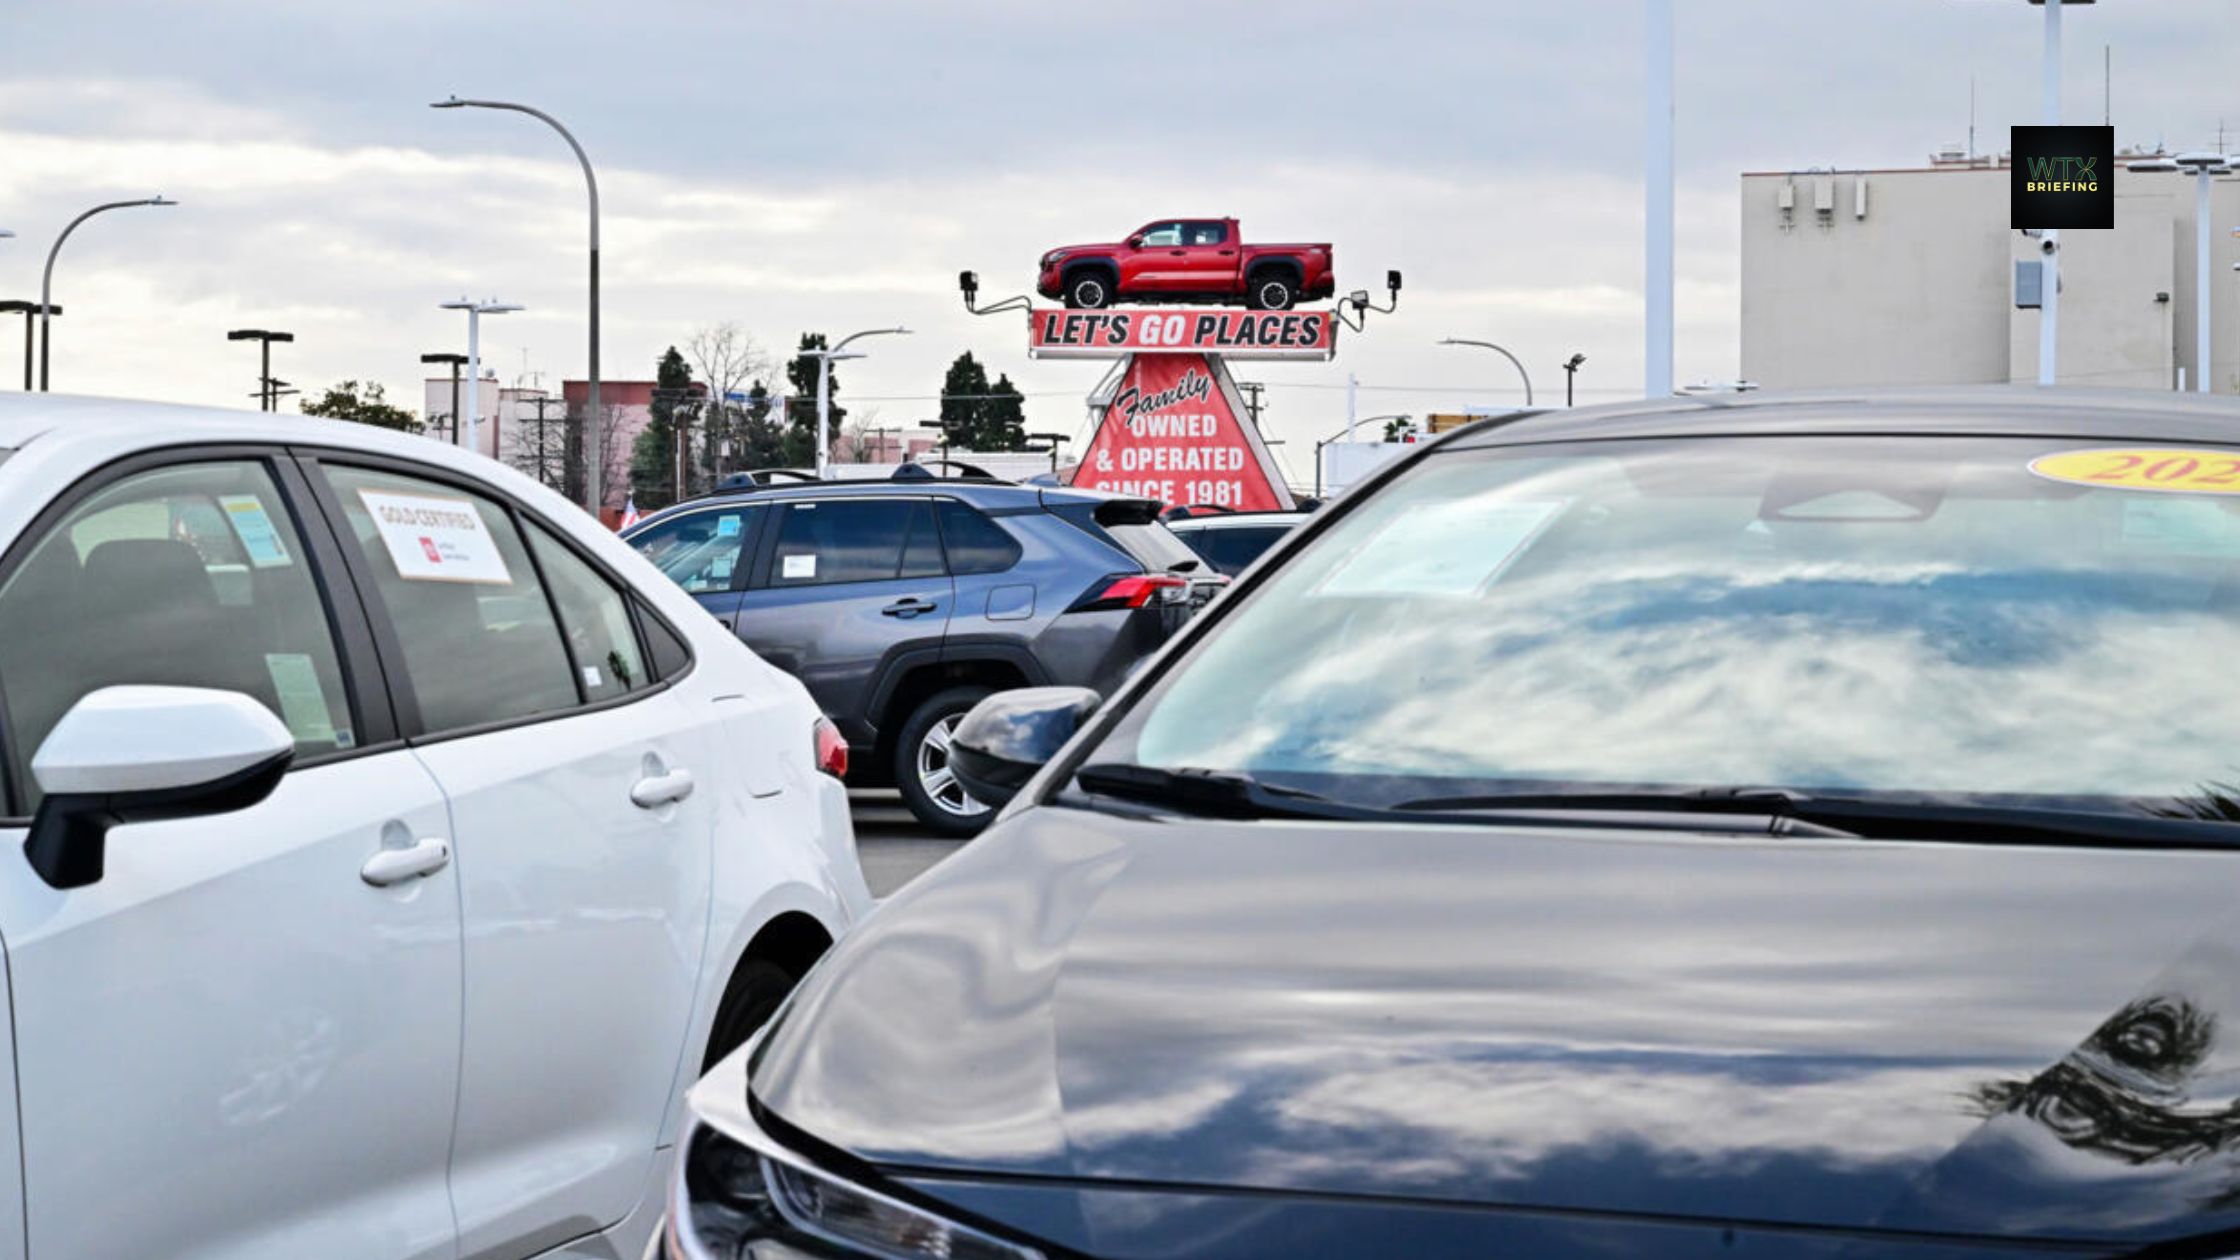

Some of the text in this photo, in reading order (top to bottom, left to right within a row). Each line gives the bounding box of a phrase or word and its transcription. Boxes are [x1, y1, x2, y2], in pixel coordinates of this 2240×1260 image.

[1043, 314, 1321, 346] LET'S GO PLACES
[1116, 369, 1211, 426] Family
[1132, 414, 1217, 437] OWNED
[1096, 447, 1244, 471] & OPERATED
[1185, 480, 1243, 505] 1981
